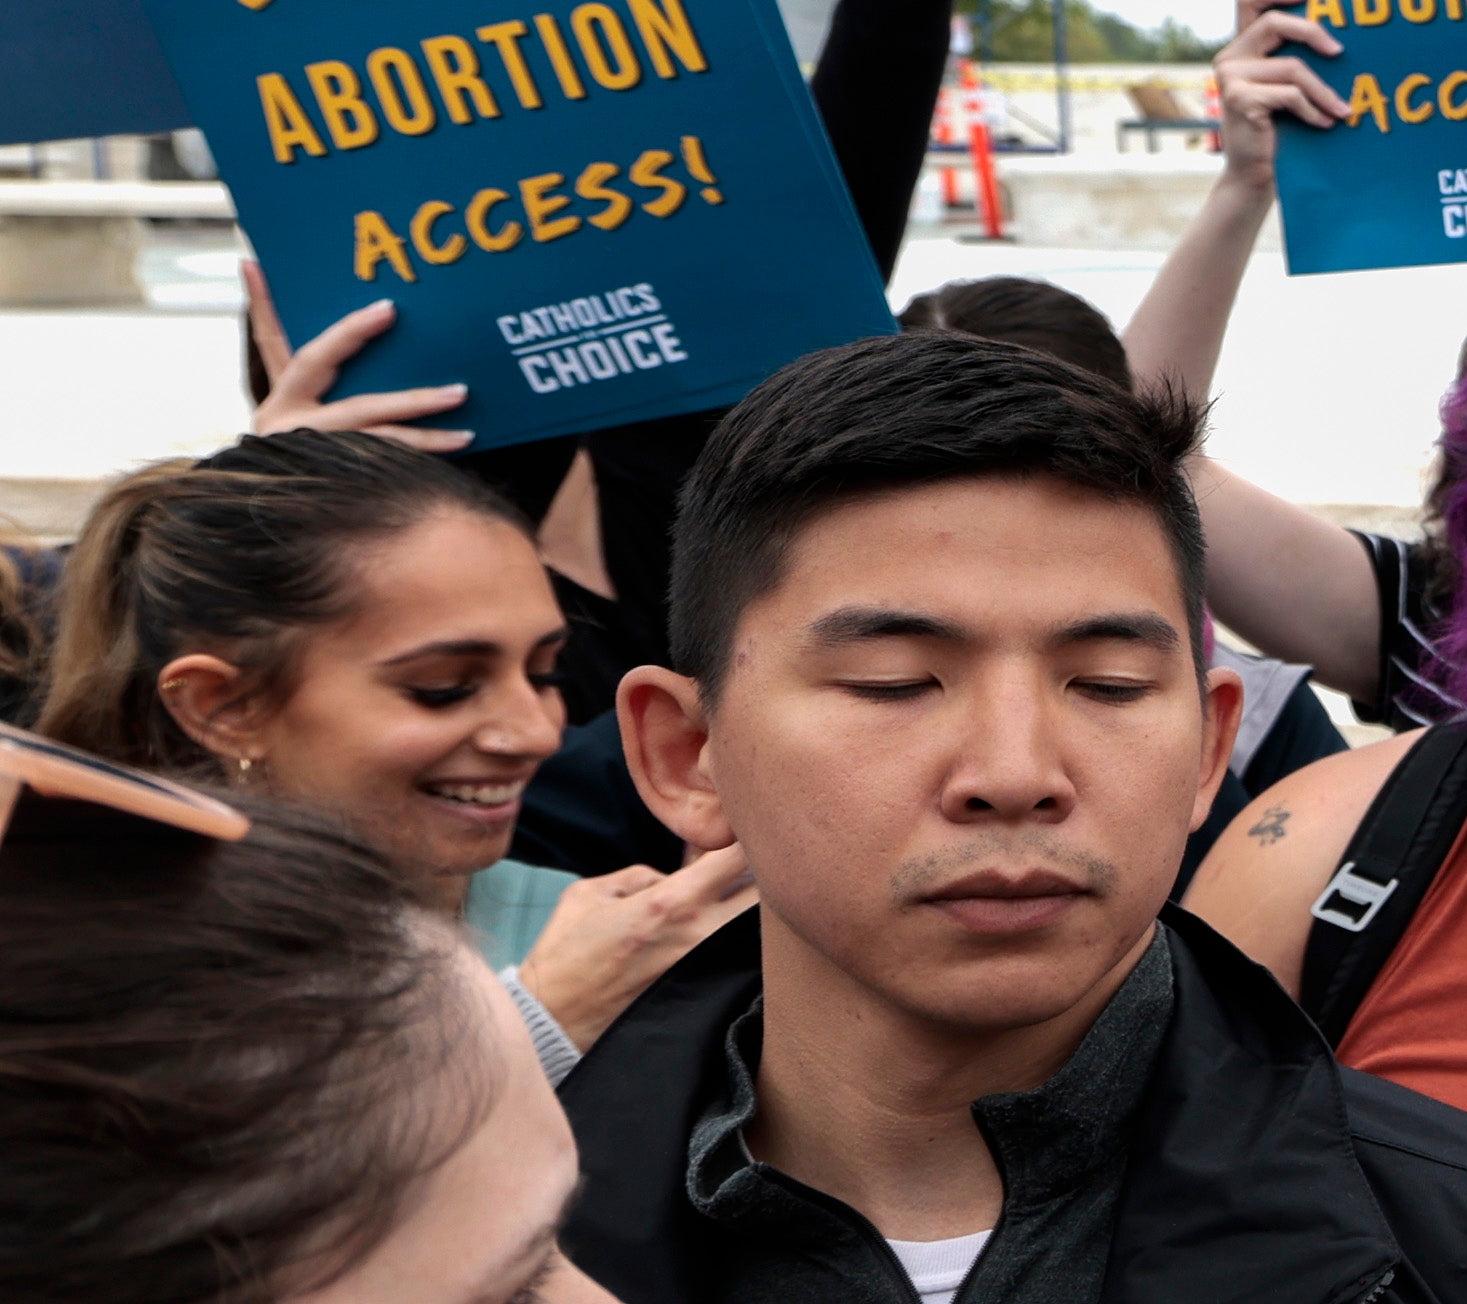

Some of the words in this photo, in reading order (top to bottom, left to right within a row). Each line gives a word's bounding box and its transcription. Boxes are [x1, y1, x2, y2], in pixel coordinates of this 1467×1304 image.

[353, 136, 726, 283] ACCESS!
[496, 282, 662, 345] CATHOLICS
[518, 322, 689, 395] CHOICE
